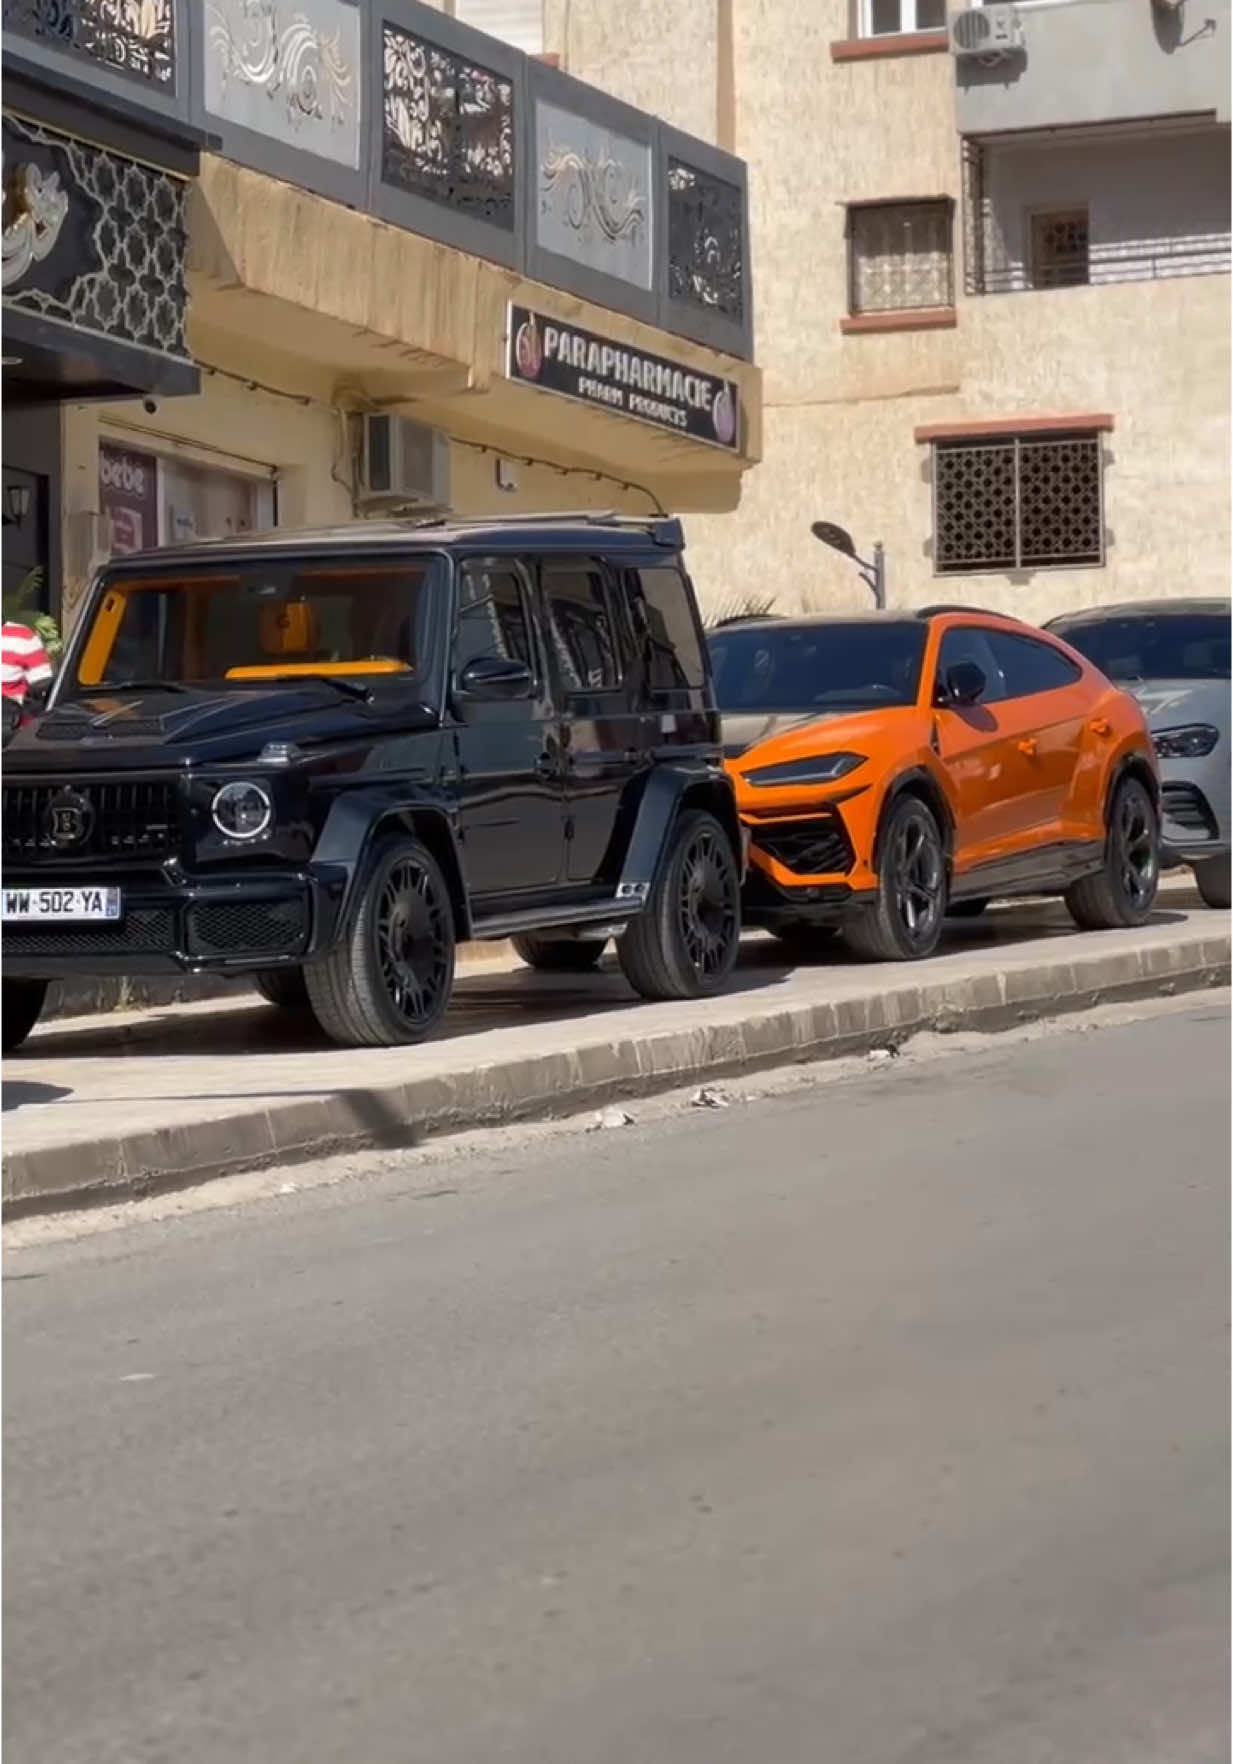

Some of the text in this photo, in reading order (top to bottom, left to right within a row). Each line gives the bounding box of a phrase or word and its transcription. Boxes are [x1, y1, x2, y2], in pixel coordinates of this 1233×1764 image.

[543, 326, 713, 411] PARAPHARMACIE
[6, 891, 30, 914] WW
[39, 890, 74, 913] 502
[81, 890, 103, 912] YA
